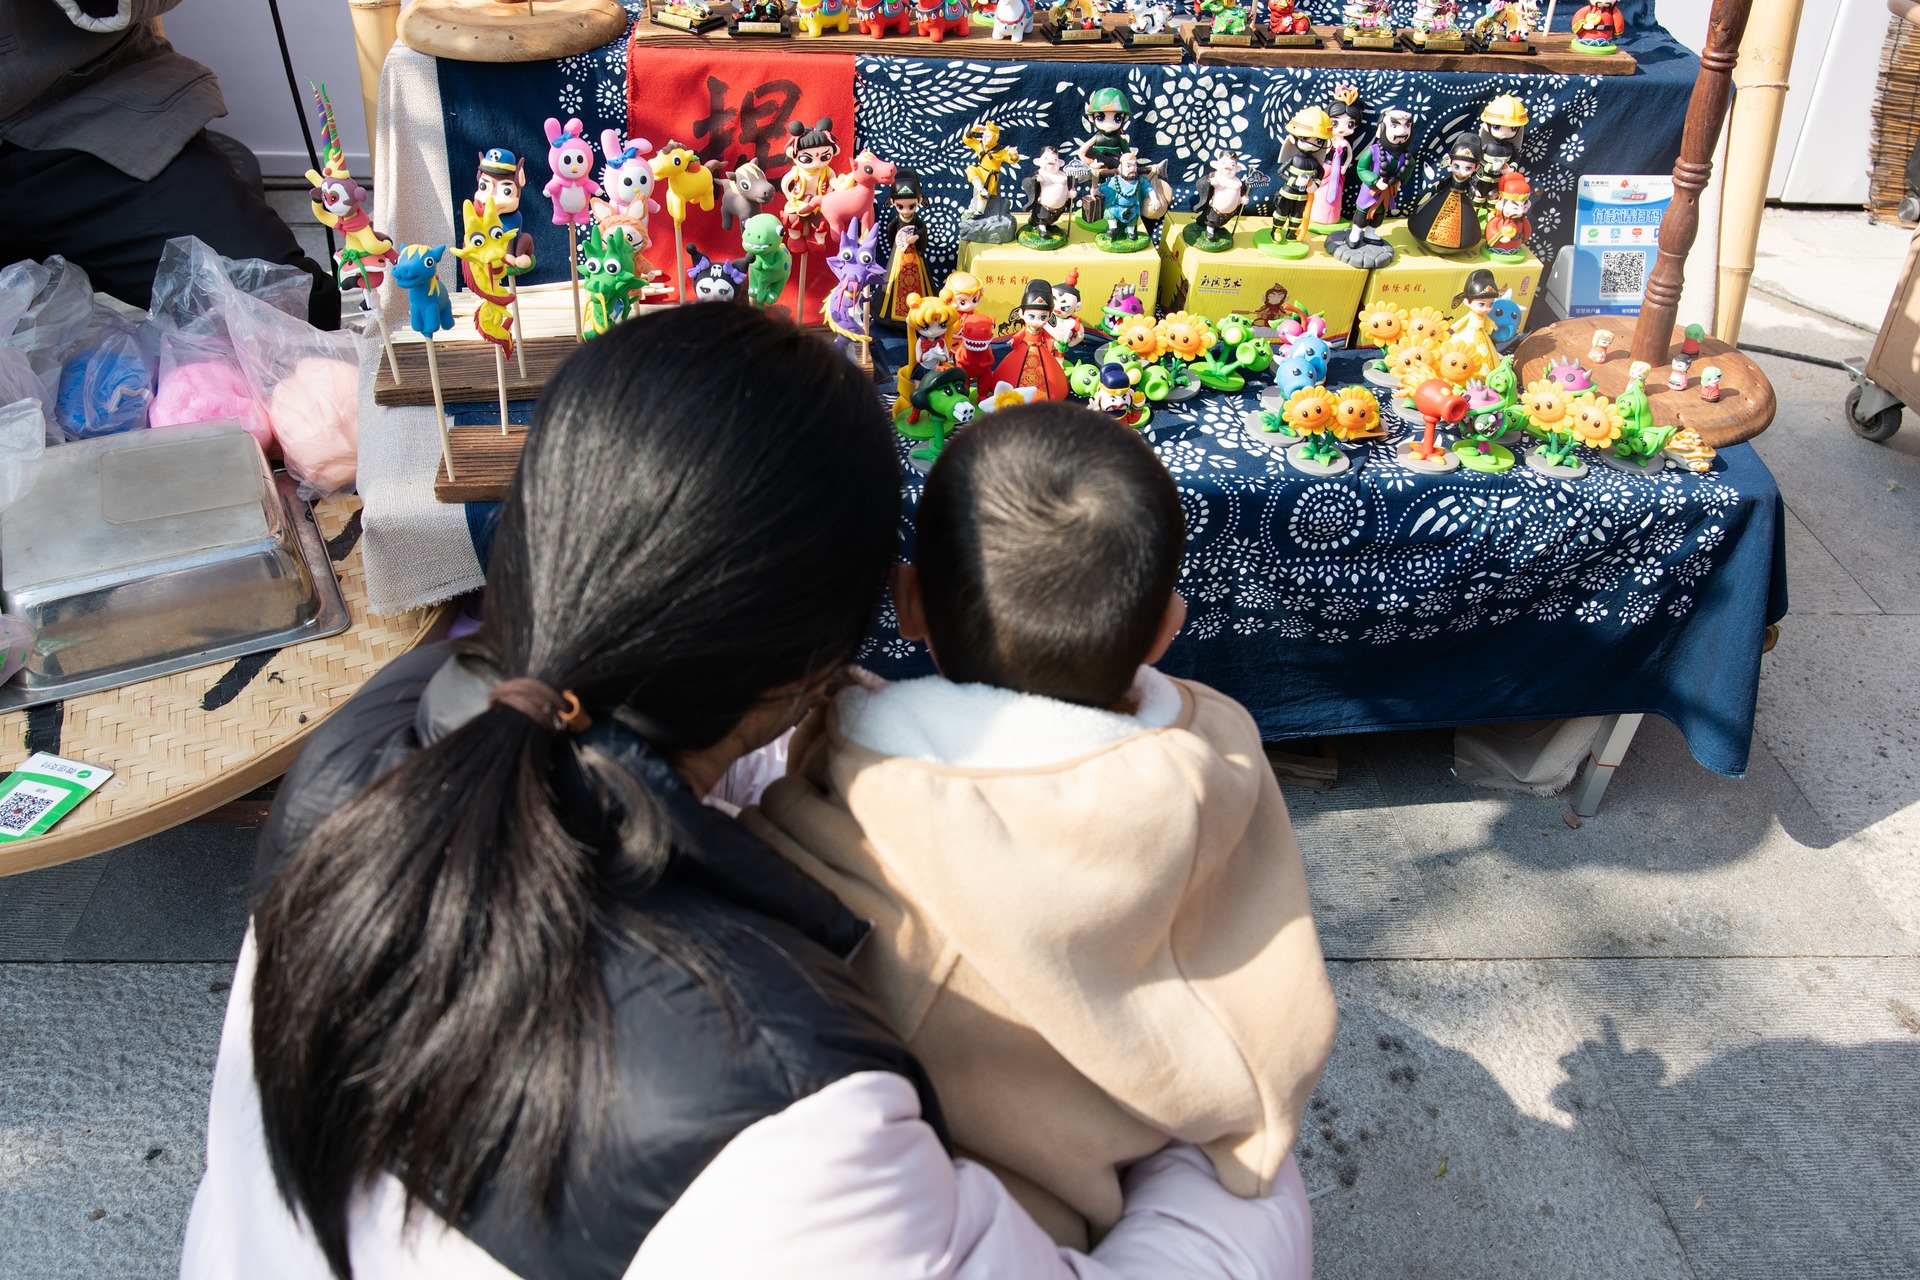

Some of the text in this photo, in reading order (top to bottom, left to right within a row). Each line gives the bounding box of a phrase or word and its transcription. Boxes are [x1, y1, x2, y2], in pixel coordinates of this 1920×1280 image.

[1593, 207, 1662, 224] 付款请扫码
[1200, 274, 1243, 289] 彩陶艺术
[40, 761, 77, 775] 微信支付
